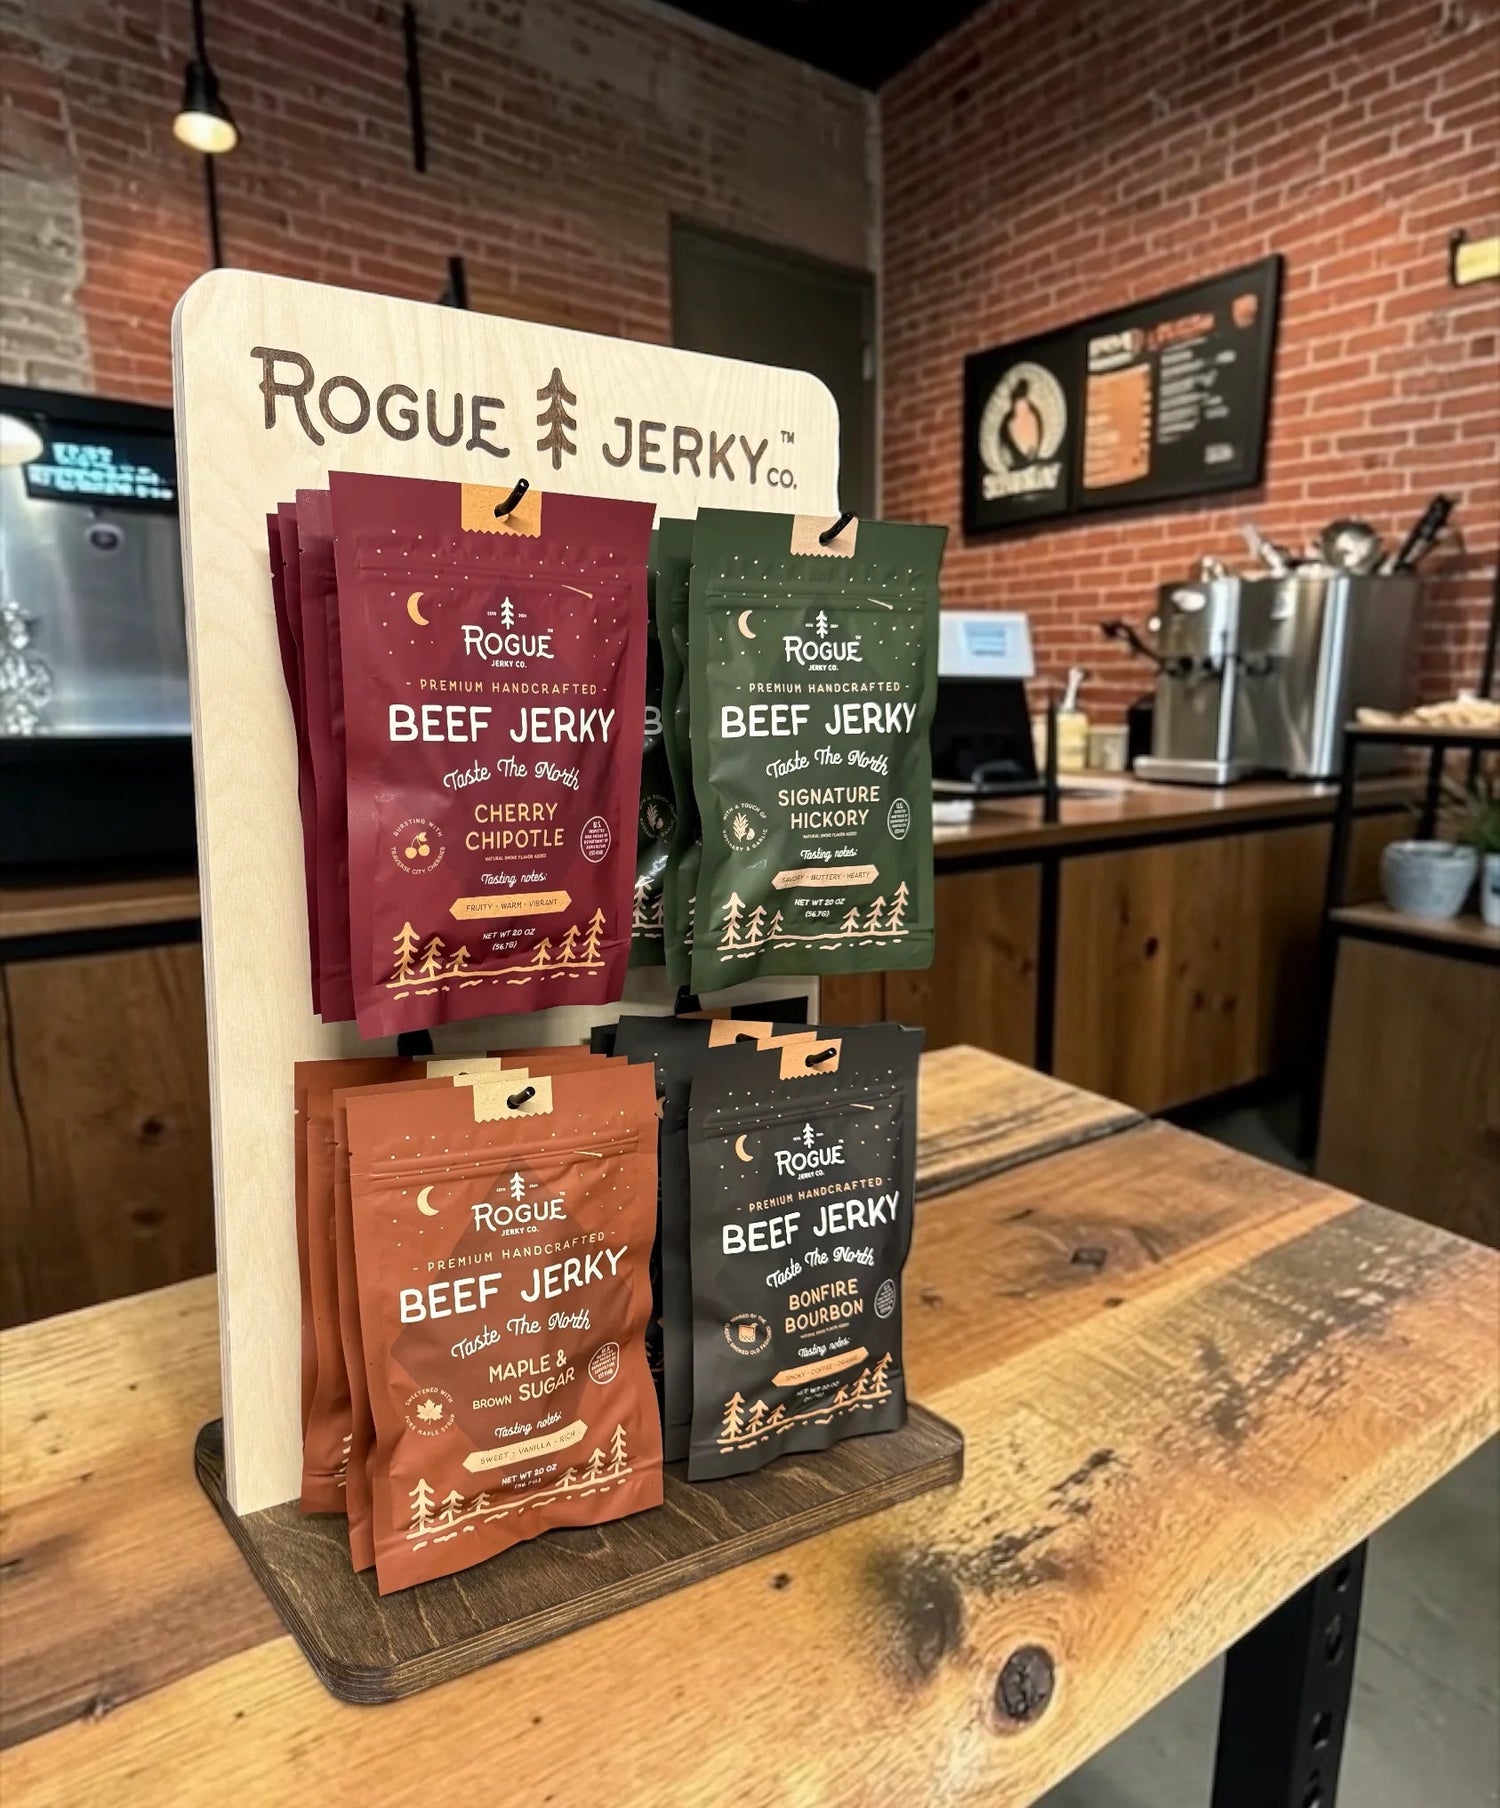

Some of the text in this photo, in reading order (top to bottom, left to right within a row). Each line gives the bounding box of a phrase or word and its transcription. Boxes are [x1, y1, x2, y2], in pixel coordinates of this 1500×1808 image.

[250, 346, 510, 458] ROGUE
[602, 417, 768, 485] JERKY
[767, 467, 798, 490] CO.
[461, 624, 554, 660] ROGUE
[783, 635, 863, 665] ROGUE
[491, 660, 527, 668] JERKY CO.
[420, 679, 597, 695] PREMIUM HANDCRAFTED
[749, 681, 900, 694] PREMIUM HANDCRAFTED
[388, 703, 492, 742] BEEF
[510, 706, 615, 743] JERKY
[720, 702, 917, 738] BEEF JERKY
[443, 755, 580, 791] Taste The North
[766, 745, 889, 778] Taste The North
[778, 785, 880, 807] SIGNATURE
[474, 802, 558, 823] CHERRY
[723, 807, 734, 820] WITH
[741, 802, 760, 812] TOUCH
[790, 808, 870, 830] HICKORY
[393, 818, 443, 837] BURSTING WITH
[465, 828, 565, 851] CHIPOTLE
[752, 828, 768, 849] GARLIC
[391, 846, 411, 873] TRAVERSE
[800, 845, 858, 862] Tasting notes:
[481, 869, 548, 888] Tasting notes:
[810, 873, 841, 881] BUTTERY
[846, 871, 870, 879] HEARTY
[466, 903, 493, 912] FRUITY
[529, 898, 557, 907] VIBRANT
[794, 898, 810, 906] NET
[482, 932, 496, 940] NET
[500, 930, 511, 938] WT
[524, 928, 536, 936] OZ
[774, 1145, 845, 1176] ROGUE
[797, 1171, 814, 1180] JERKY
[749, 1177, 883, 1212] PREMIUM HANDCRAFTED
[471, 1199, 567, 1232] ROGUE
[722, 1190, 900, 1255] BEEF JERKY
[501, 1225, 540, 1236] JERKY CO.
[427, 1231, 605, 1272] PREMIUM HANDCRAFTED
[766, 1246, 875, 1288] Taste The North
[400, 1245, 628, 1324] BEEF JERKY
[789, 1278, 858, 1311] BONFIRE
[785, 1298, 864, 1334] BOURBON
[451, 1308, 591, 1360] Taste The North
[798, 1343, 827, 1358] Tasting
[489, 1354, 551, 1384] MAPLE
[557, 1348, 567, 1368] &
[405, 1387, 453, 1406] SWEETENED WITH
[472, 1367, 575, 1411] BROWN SUGAR
[405, 1415, 416, 1431] PURE
[440, 1413, 455, 1432] SYRUP
[494, 1411, 562, 1438] Tasting notes:
[480, 1430, 576, 1465] SWEET VANILLA RICH
[501, 1475, 517, 1486] NET
[519, 1470, 532, 1481] WT
[545, 1463, 558, 1472] OZ
